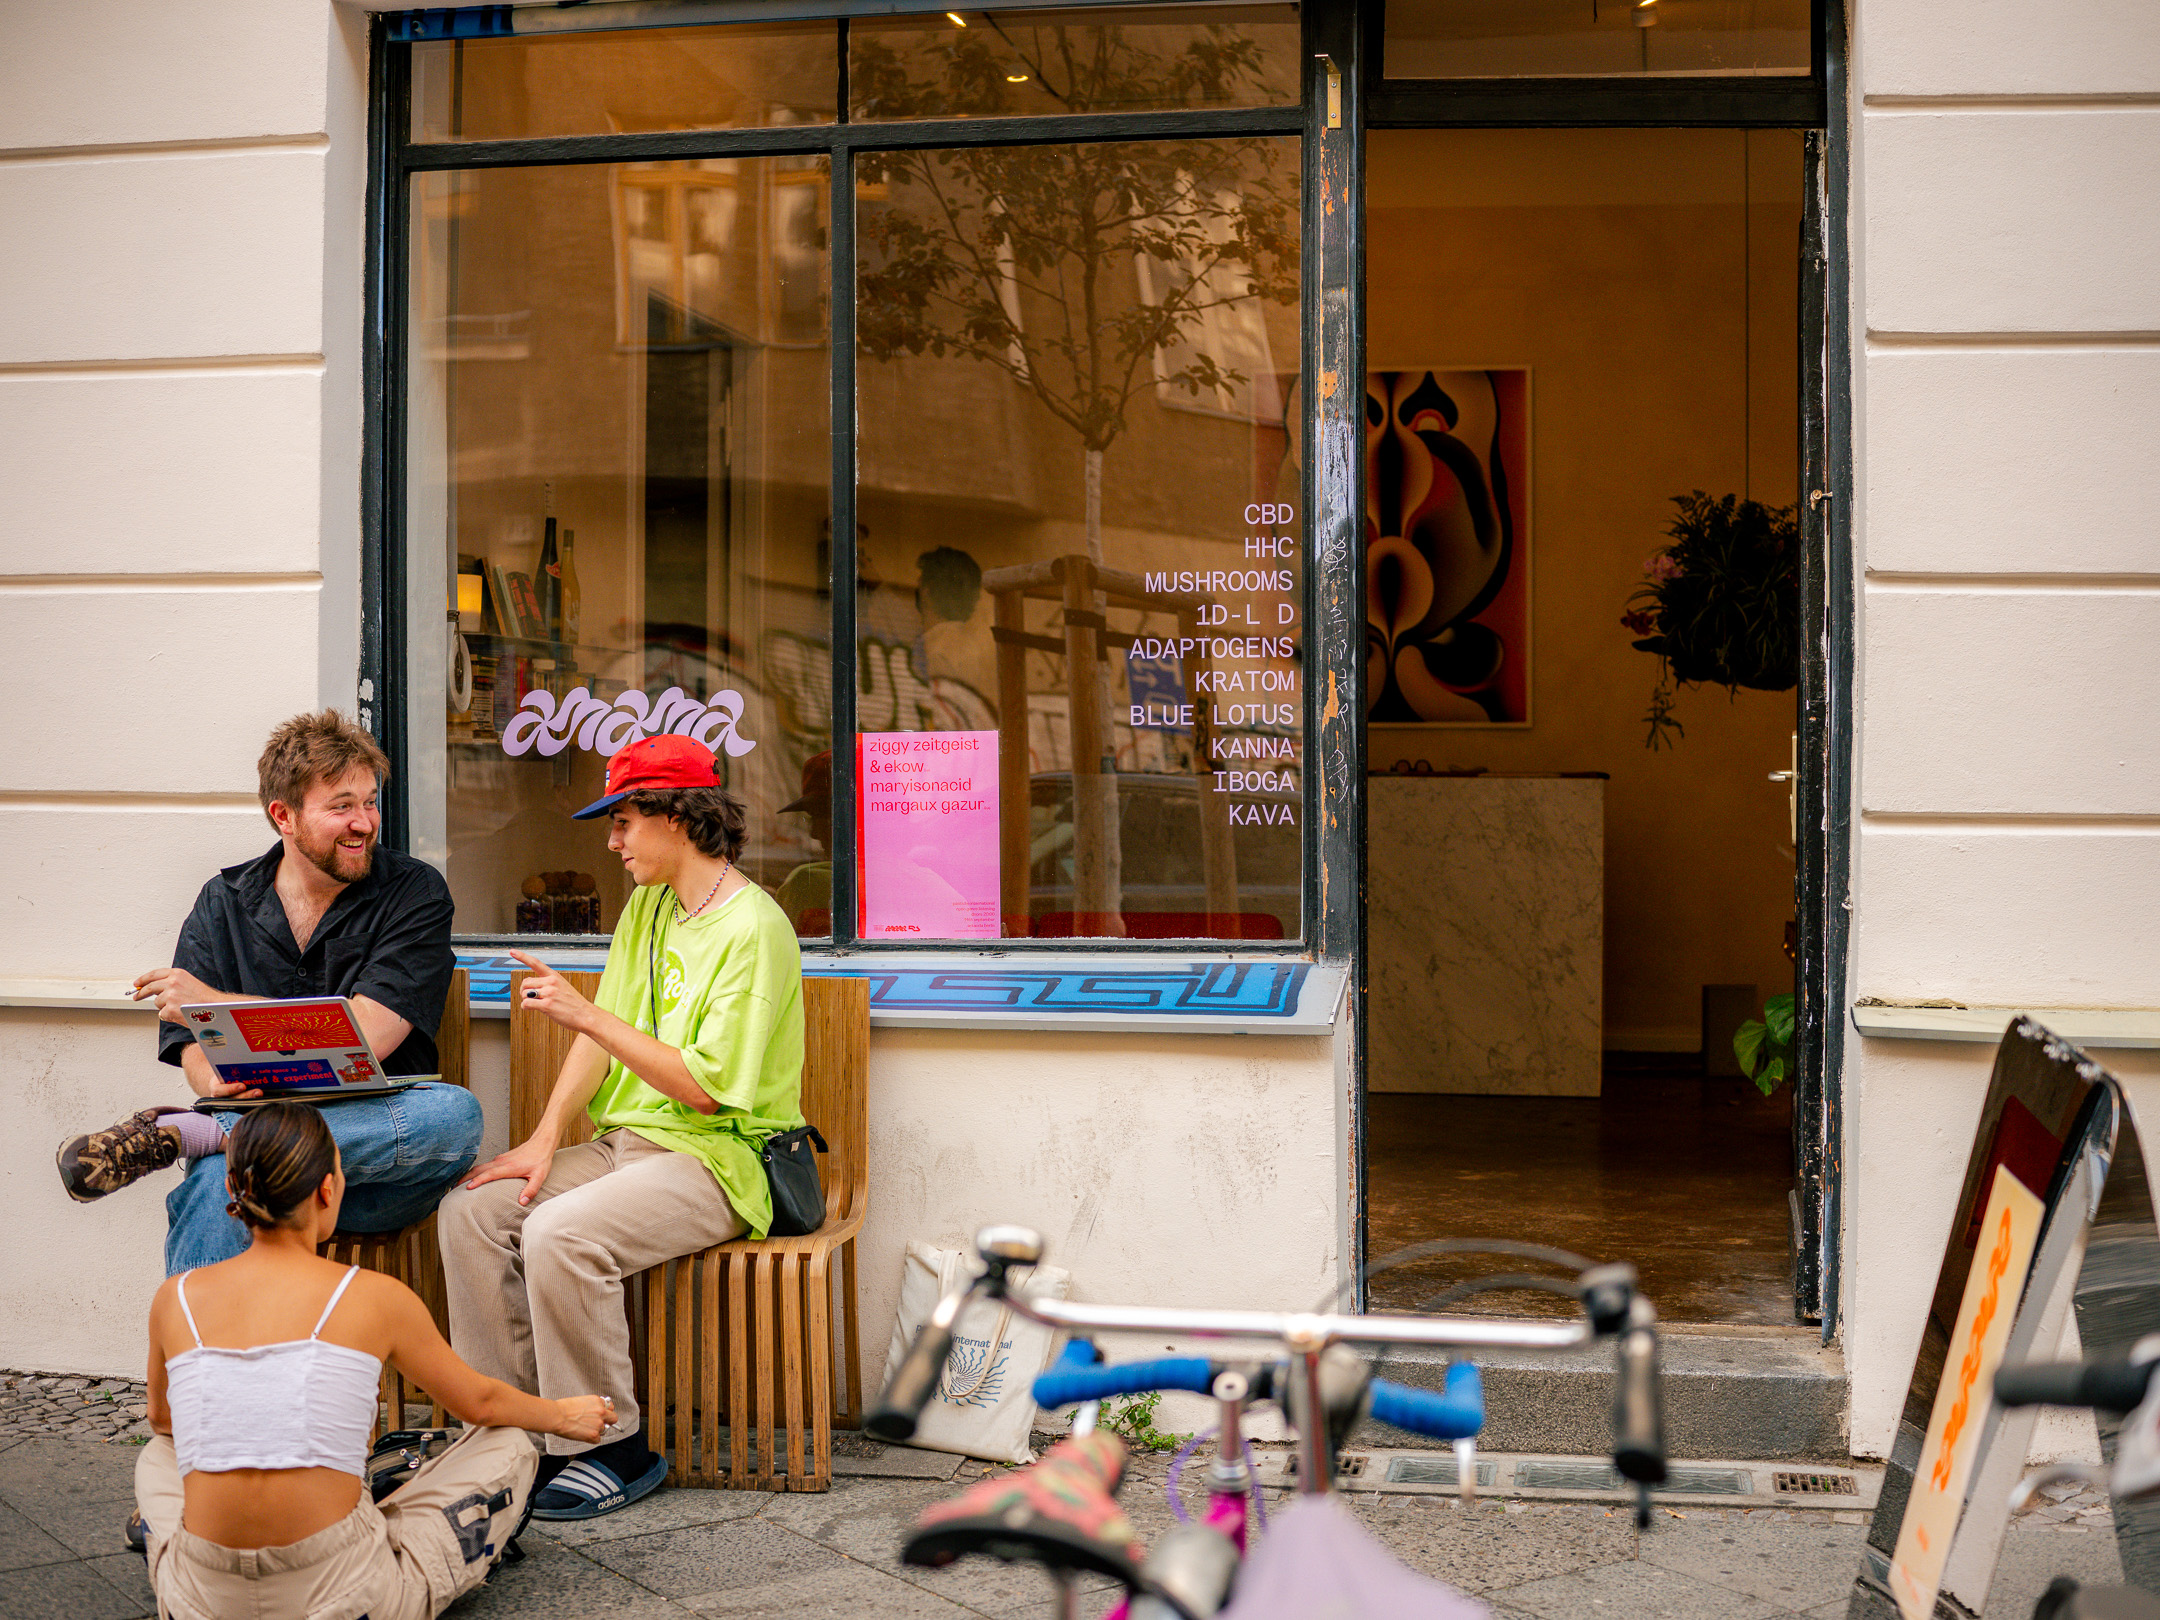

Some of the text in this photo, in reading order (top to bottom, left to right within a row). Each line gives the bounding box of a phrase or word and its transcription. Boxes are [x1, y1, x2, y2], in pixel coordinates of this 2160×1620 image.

[1244, 504, 1294, 525] CBD
[1244, 537, 1294, 558] HHC
[1145, 570, 1294, 593] MUSHROOMS
[1129, 637, 1294, 660] ADAPTOGENS
[1195, 670, 1295, 692] KRATOM
[1130, 704, 1294, 726] BLUE LOTUS
[869, 737, 980, 755] ziggy zeitgeist
[1212, 737, 1295, 759] KANNA
[869, 760, 925, 774] & ekow
[870, 777, 972, 796] maryisonacid
[1213, 771, 1295, 792] IBOGA
[871, 799, 985, 815] margaux gazur
[1229, 804, 1295, 826] KAVA
[242, 1076, 269, 1086] weird
[272, 1075, 280, 1083] &
[284, 1071, 334, 1083] experiment
[953, 1333, 1013, 1349] internatnal
[597, 1494, 626, 1510] adidas
